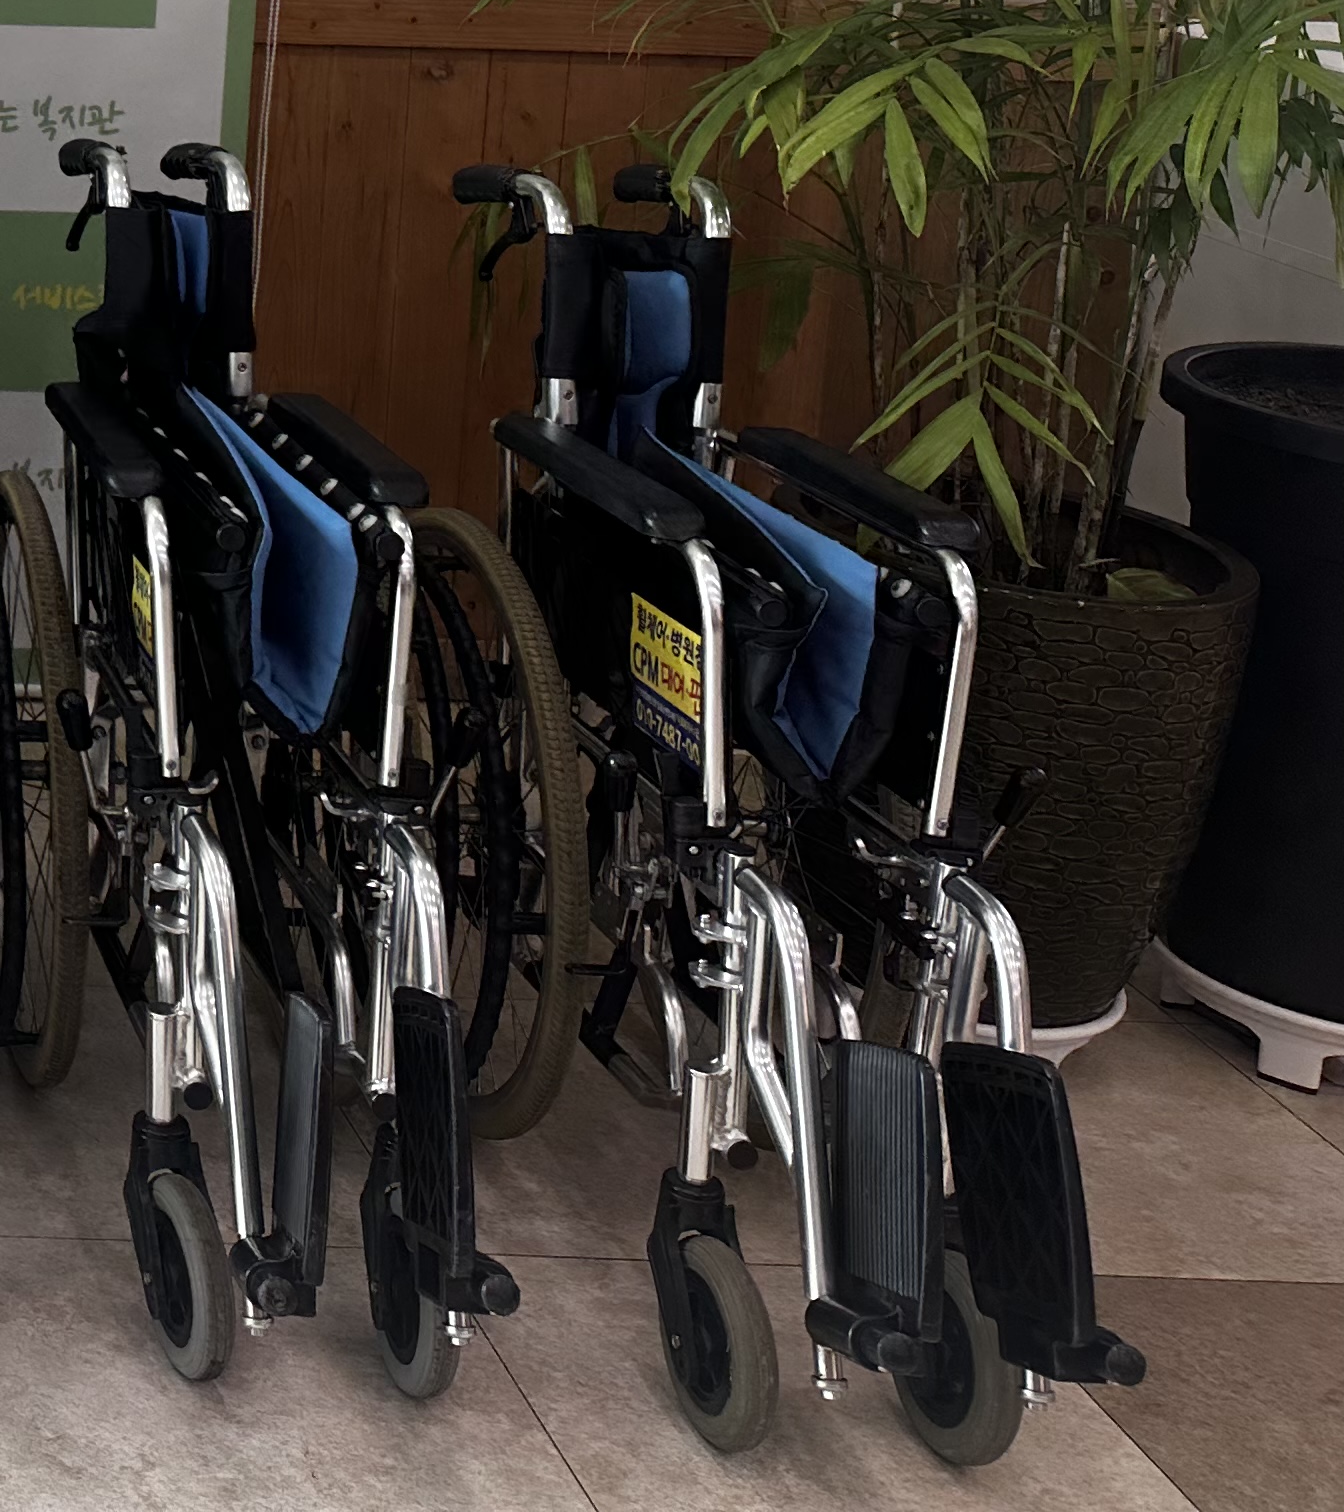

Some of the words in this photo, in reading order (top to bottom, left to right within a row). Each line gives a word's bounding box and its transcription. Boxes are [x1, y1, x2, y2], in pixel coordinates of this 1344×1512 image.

[32, 95, 125, 141] 복지관
[13, 283, 104, 311] 서비스
[633, 642, 659, 687] CPM
